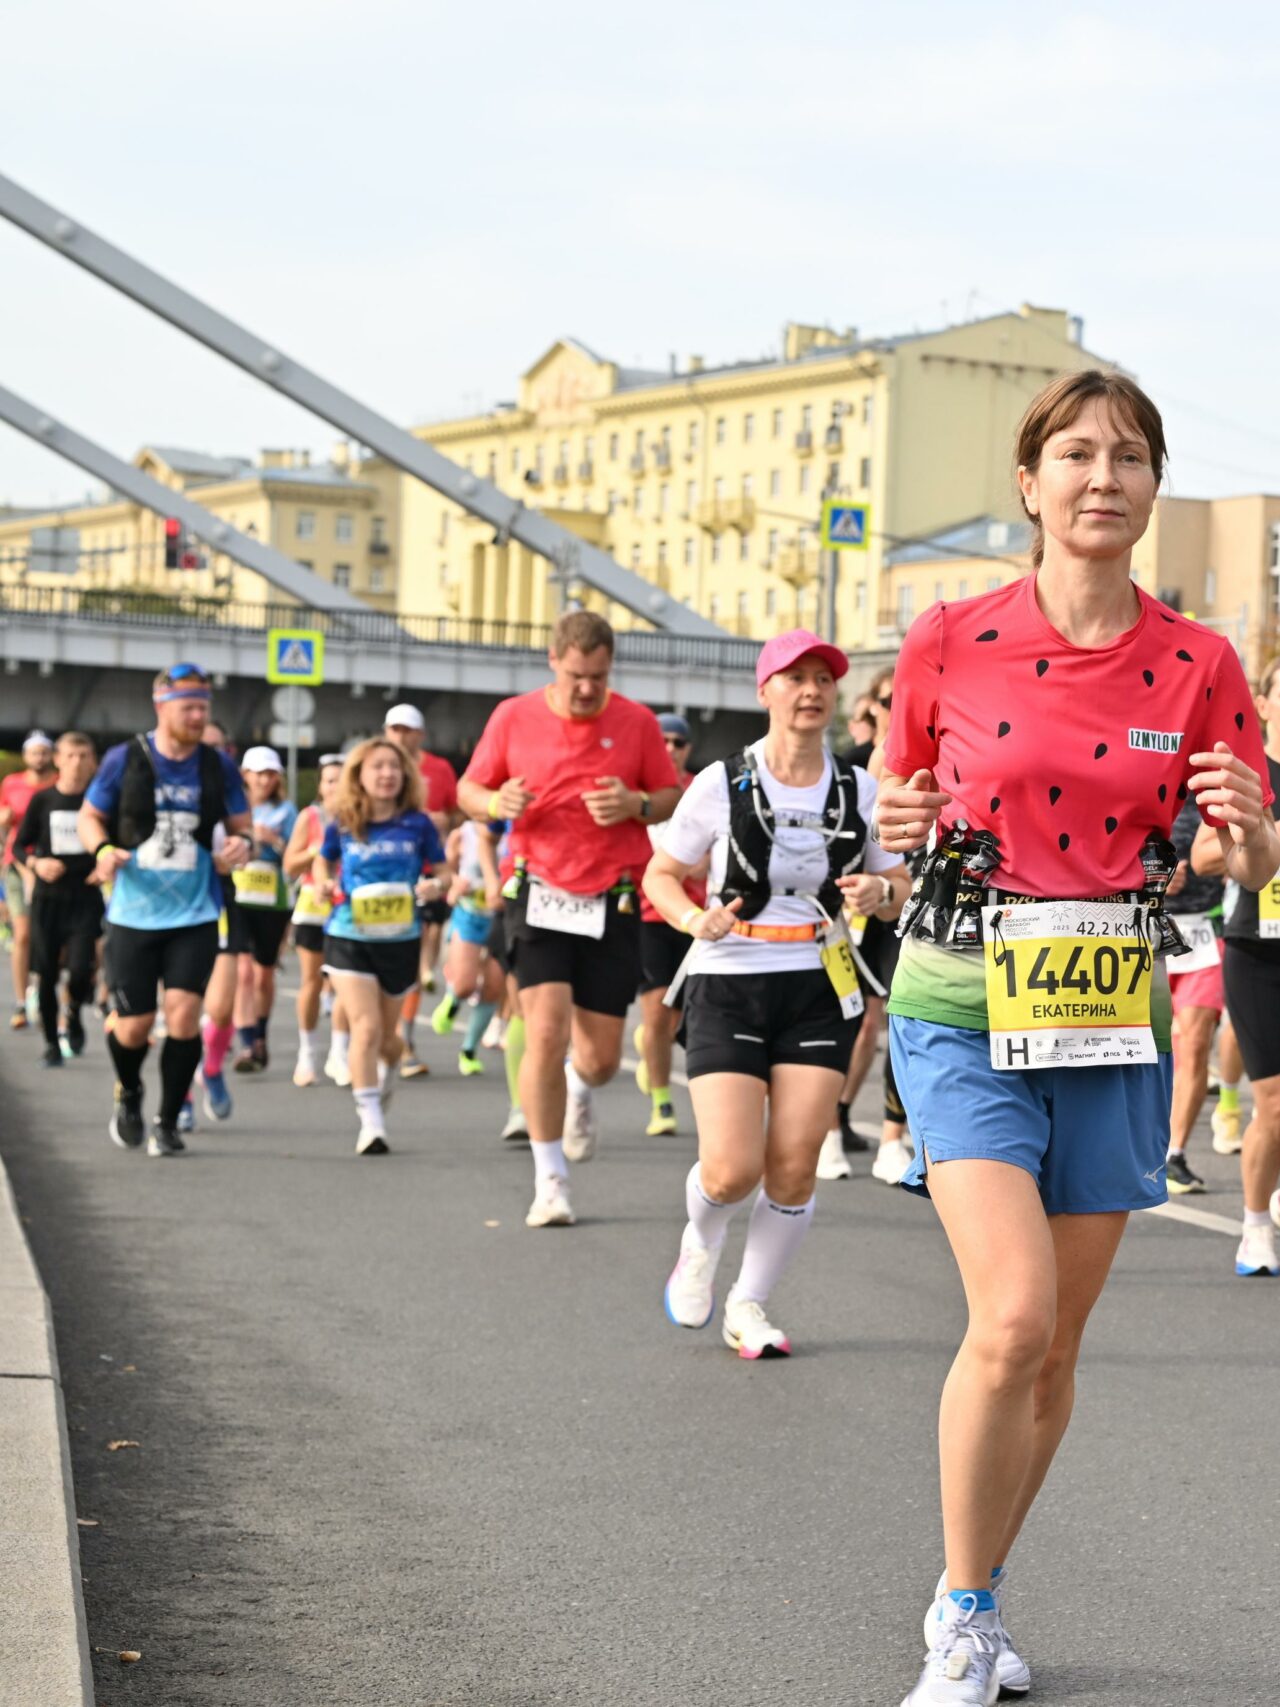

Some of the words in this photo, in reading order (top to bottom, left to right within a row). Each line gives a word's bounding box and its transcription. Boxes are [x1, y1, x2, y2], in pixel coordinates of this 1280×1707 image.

[1076, 921, 1110, 938] 42,2
[996, 945, 1147, 998] 14407
[1032, 1003, 1117, 1019] ЕКАТЕРИНА
